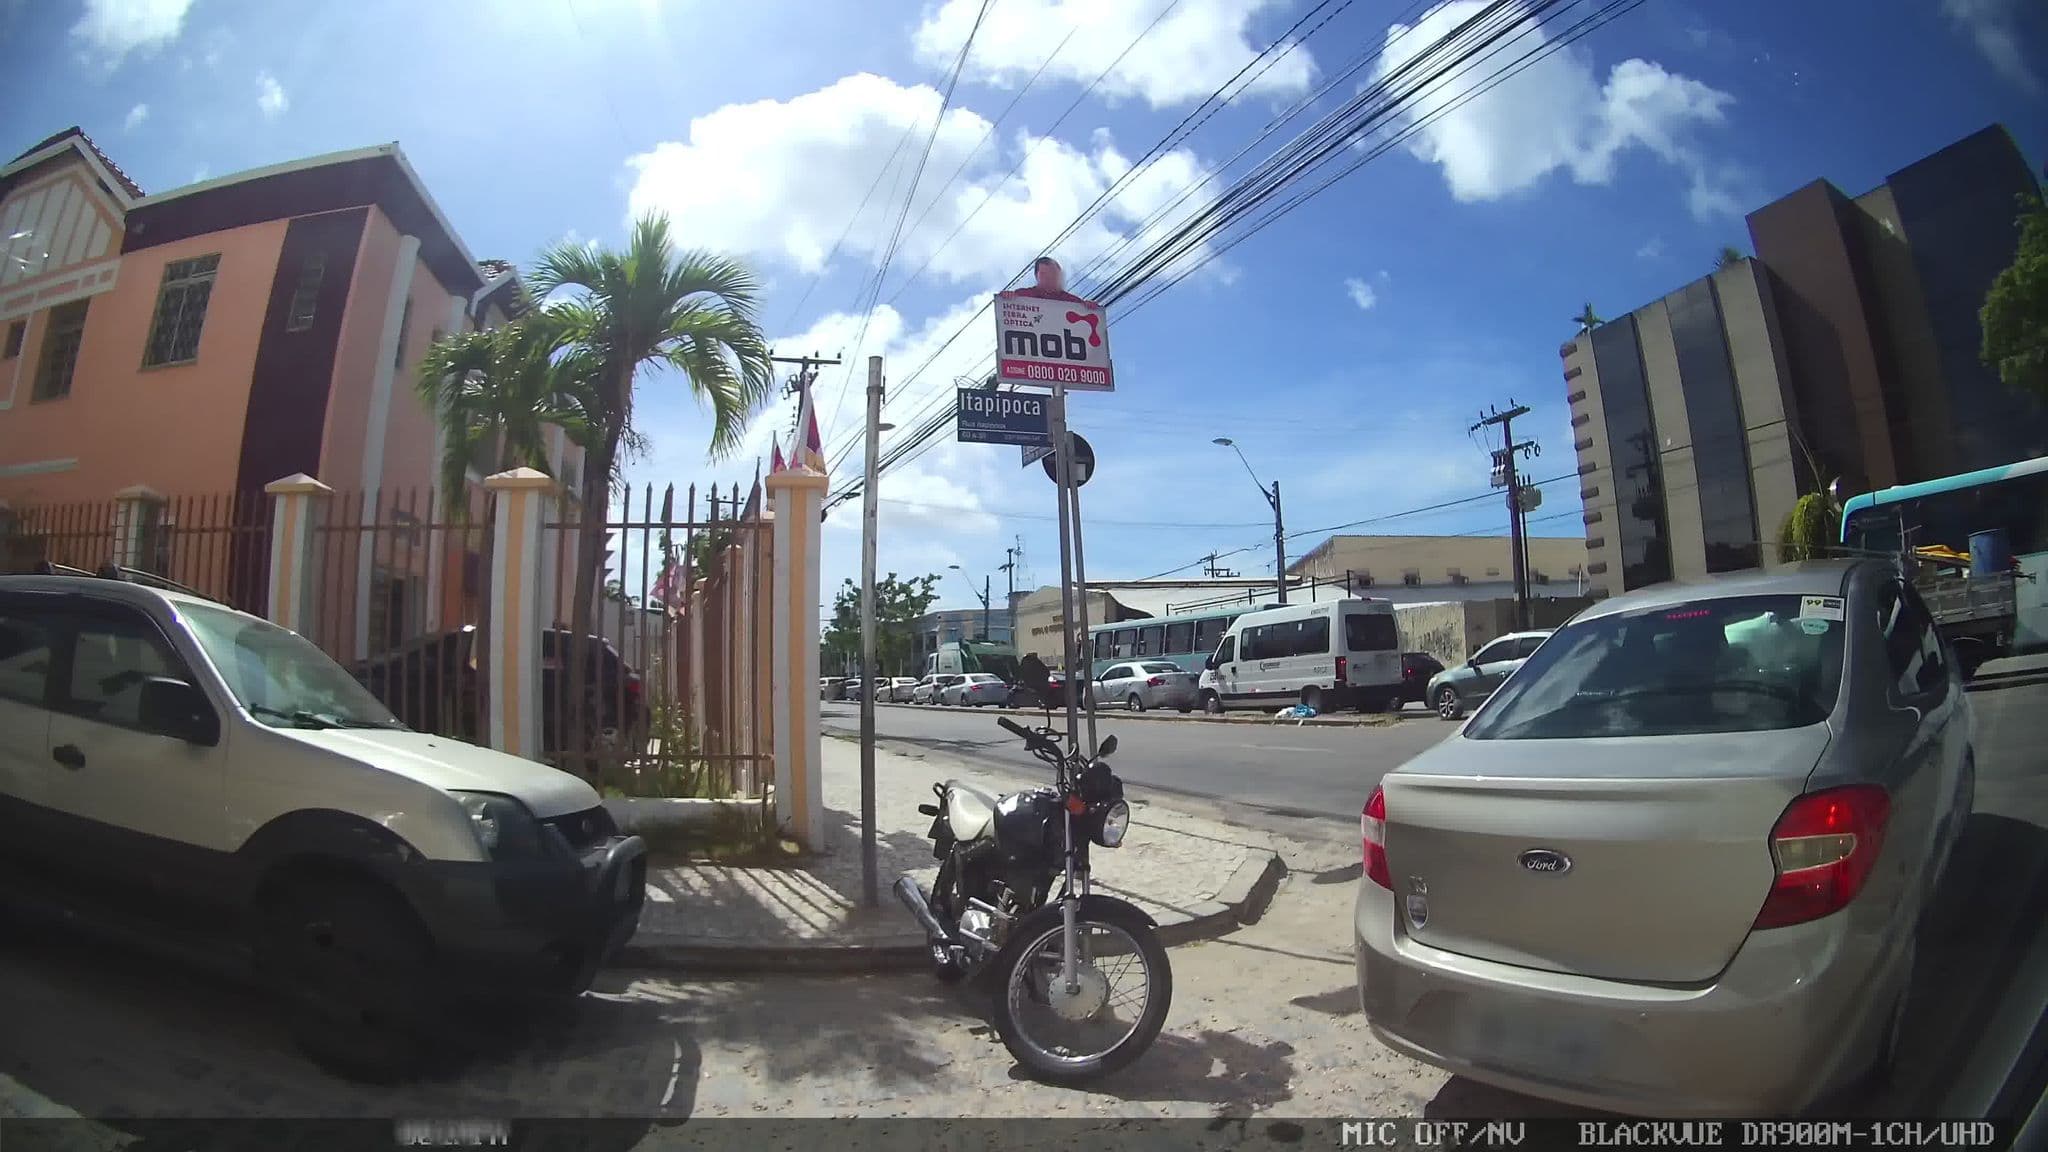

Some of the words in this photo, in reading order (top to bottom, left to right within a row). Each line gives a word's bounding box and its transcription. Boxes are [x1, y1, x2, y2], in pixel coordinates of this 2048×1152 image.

[1003, 303, 1040, 312] INTERNET
[1003, 311, 1027, 319] FIBRA
[1005, 328, 1087, 361] mob
[1027, 364, 1054, 380] 0800
[1058, 367, 1077, 382] 020
[1080, 370, 1105, 384] 9000
[961, 392, 1041, 418] Itapipoca
[1527, 857, 1557, 871] Ford
